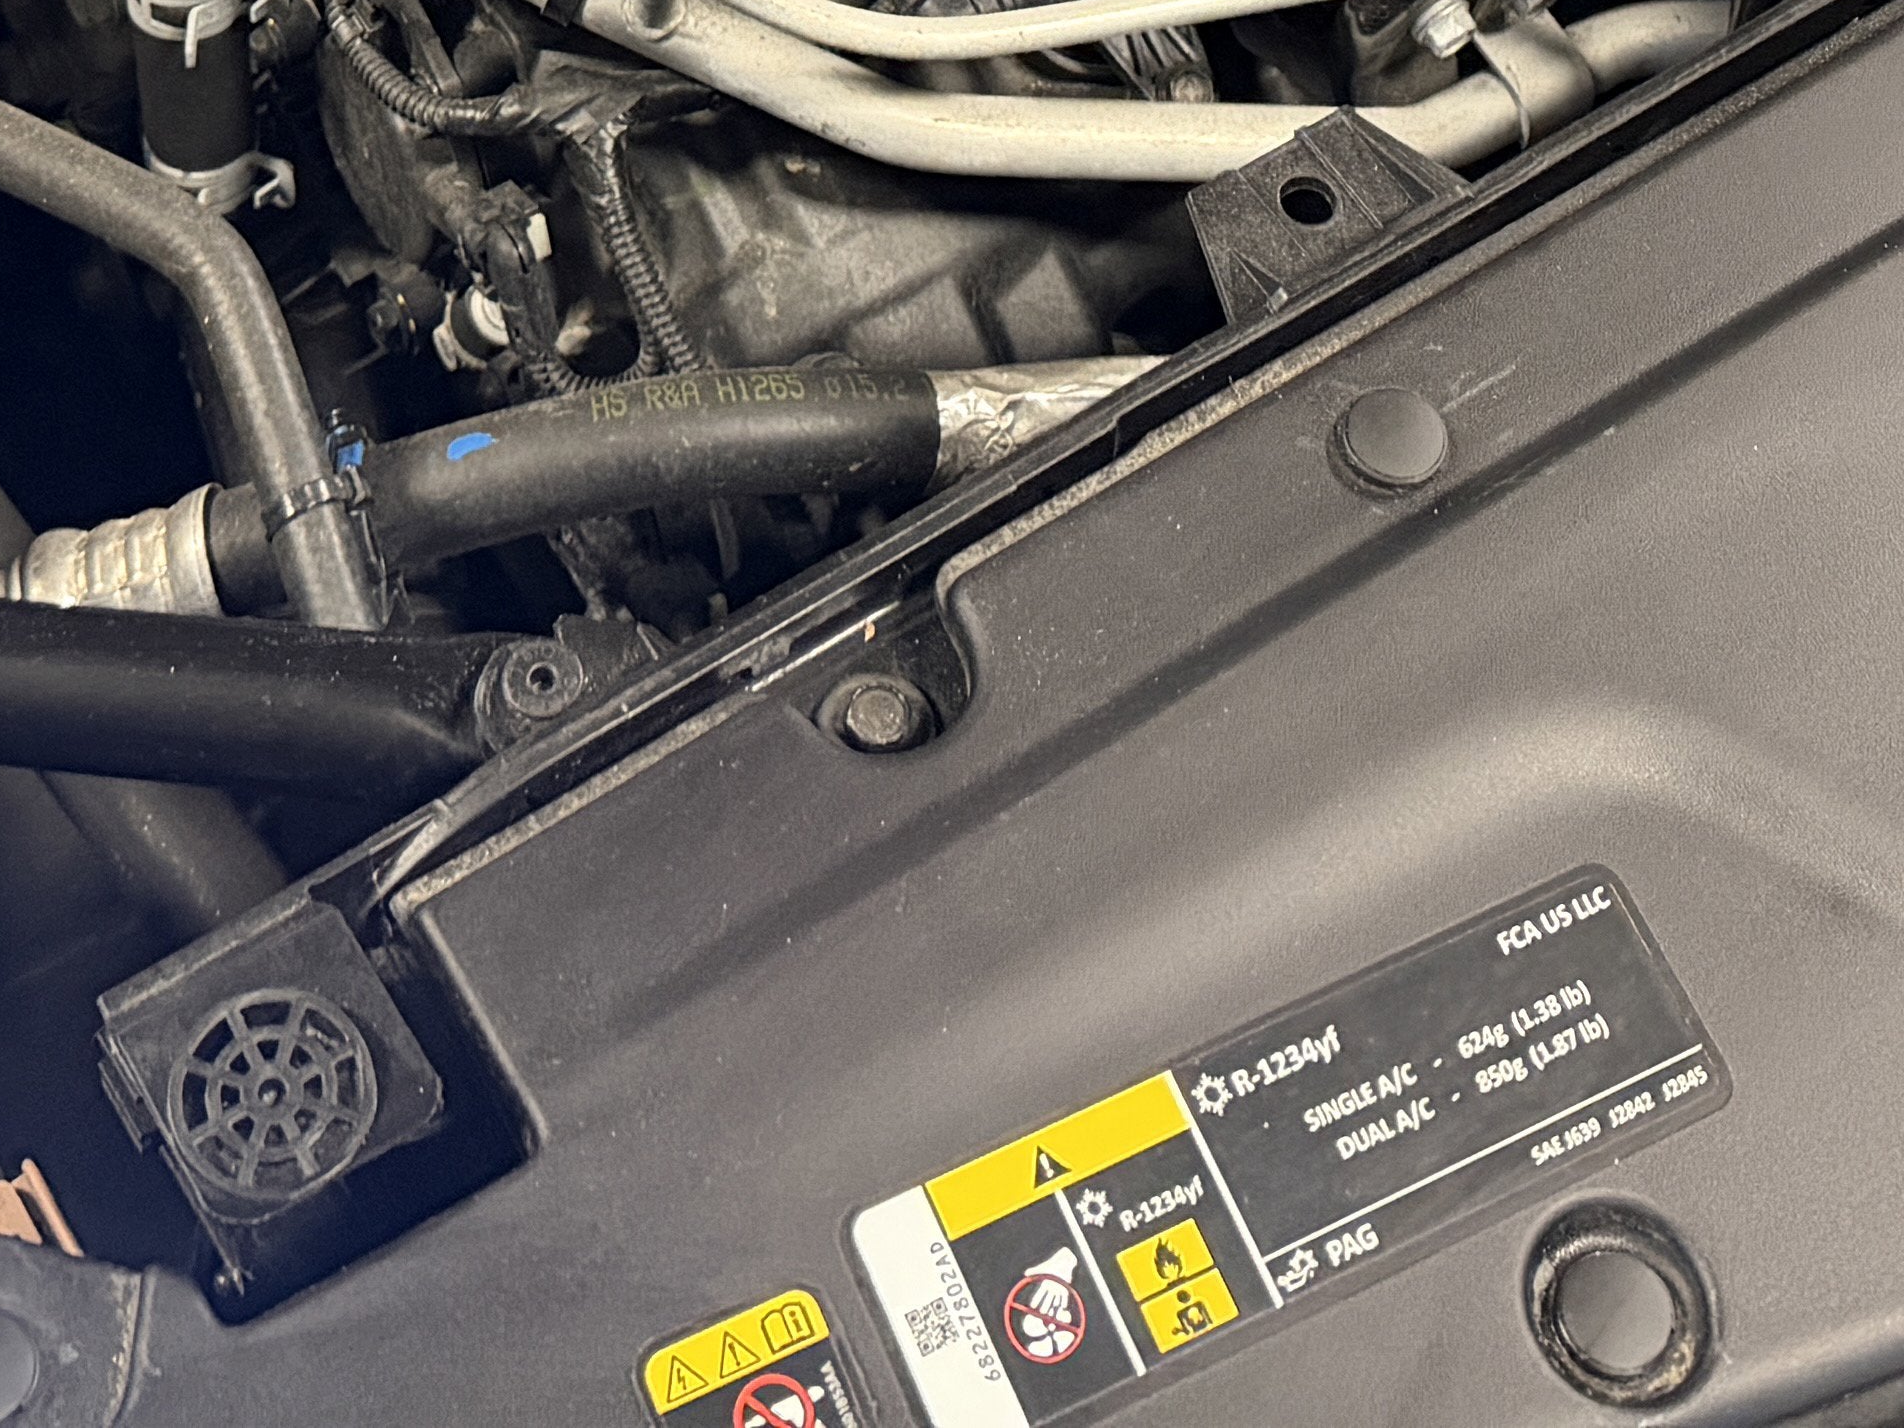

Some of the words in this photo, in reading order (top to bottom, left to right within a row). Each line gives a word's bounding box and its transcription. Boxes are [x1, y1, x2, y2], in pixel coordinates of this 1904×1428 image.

[591, 395, 628, 422] HS
[645, 380, 700, 410] R&A
[715, 374, 805, 403] H1265
[1497, 917, 1542, 955] FCA
[1542, 903, 1574, 935] US
[1573, 885, 1611, 922] LLC
[1230, 1024, 1342, 1097] R-1234yf
[1303, 1084, 1377, 1133] SINGLE
[1376, 1062, 1418, 1109] A/C
[1457, 1022, 1510, 1061] 624g
[1510, 995, 1562, 1037] (1.38
[1559, 979, 1592, 1007] lb)
[1335, 1119, 1398, 1160] DUAL
[1395, 1097, 1437, 1136] A/C
[1474, 1057, 1529, 1097] 850g
[1529, 1031, 1580, 1072] (1.87
[1578, 1013, 1610, 1043] lb)
[1531, 1130, 1564, 1166] SAE
[1564, 1119, 1602, 1153] J639
[1608, 1091, 1656, 1129] J2842
[1661, 1064, 1709, 1103] J2845
[1118, 1174, 1206, 1232] R-1234yf
[1324, 1223, 1381, 1268] PAG
[929, 1240, 1002, 1383] 68227802AD
